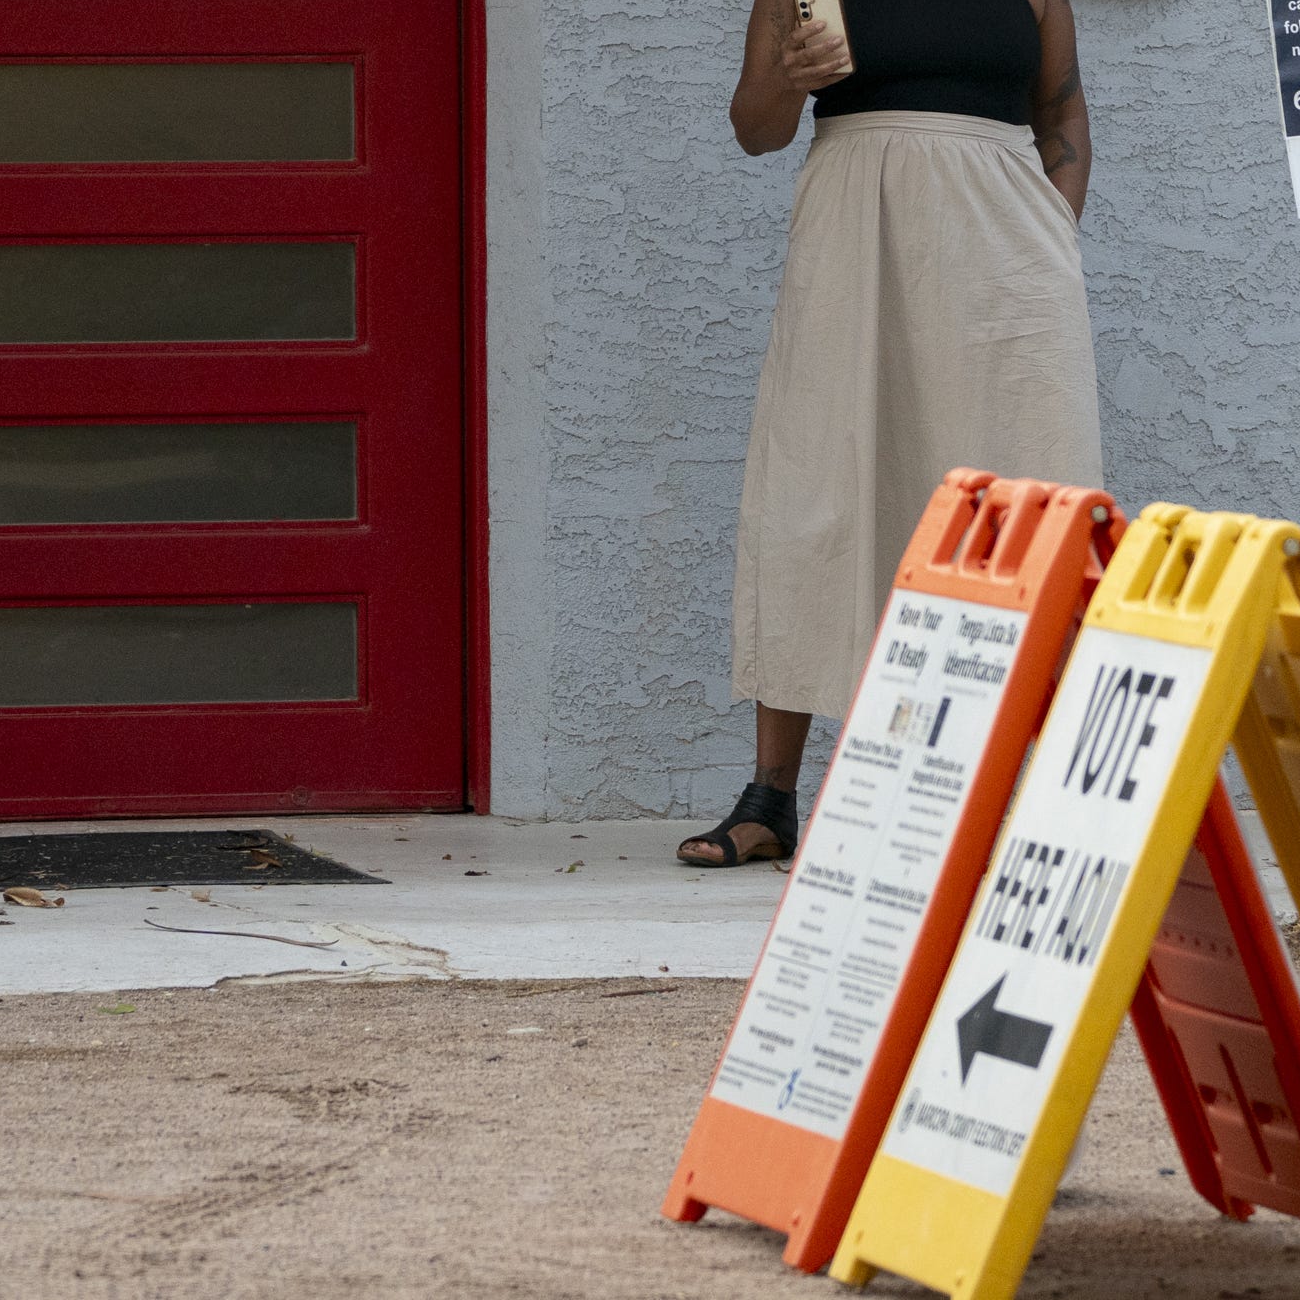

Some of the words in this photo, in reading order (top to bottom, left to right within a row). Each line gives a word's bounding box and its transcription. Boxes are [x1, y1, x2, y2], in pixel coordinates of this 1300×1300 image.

[897, 602, 921, 627] Have
[922, 605, 944, 631] Your
[956, 613, 985, 646] Tenga
[886, 639, 900, 665] ID
[897, 642, 930, 677] Ready
[1061, 663, 1176, 803] VOTE
[975, 837, 1065, 950] HERE
